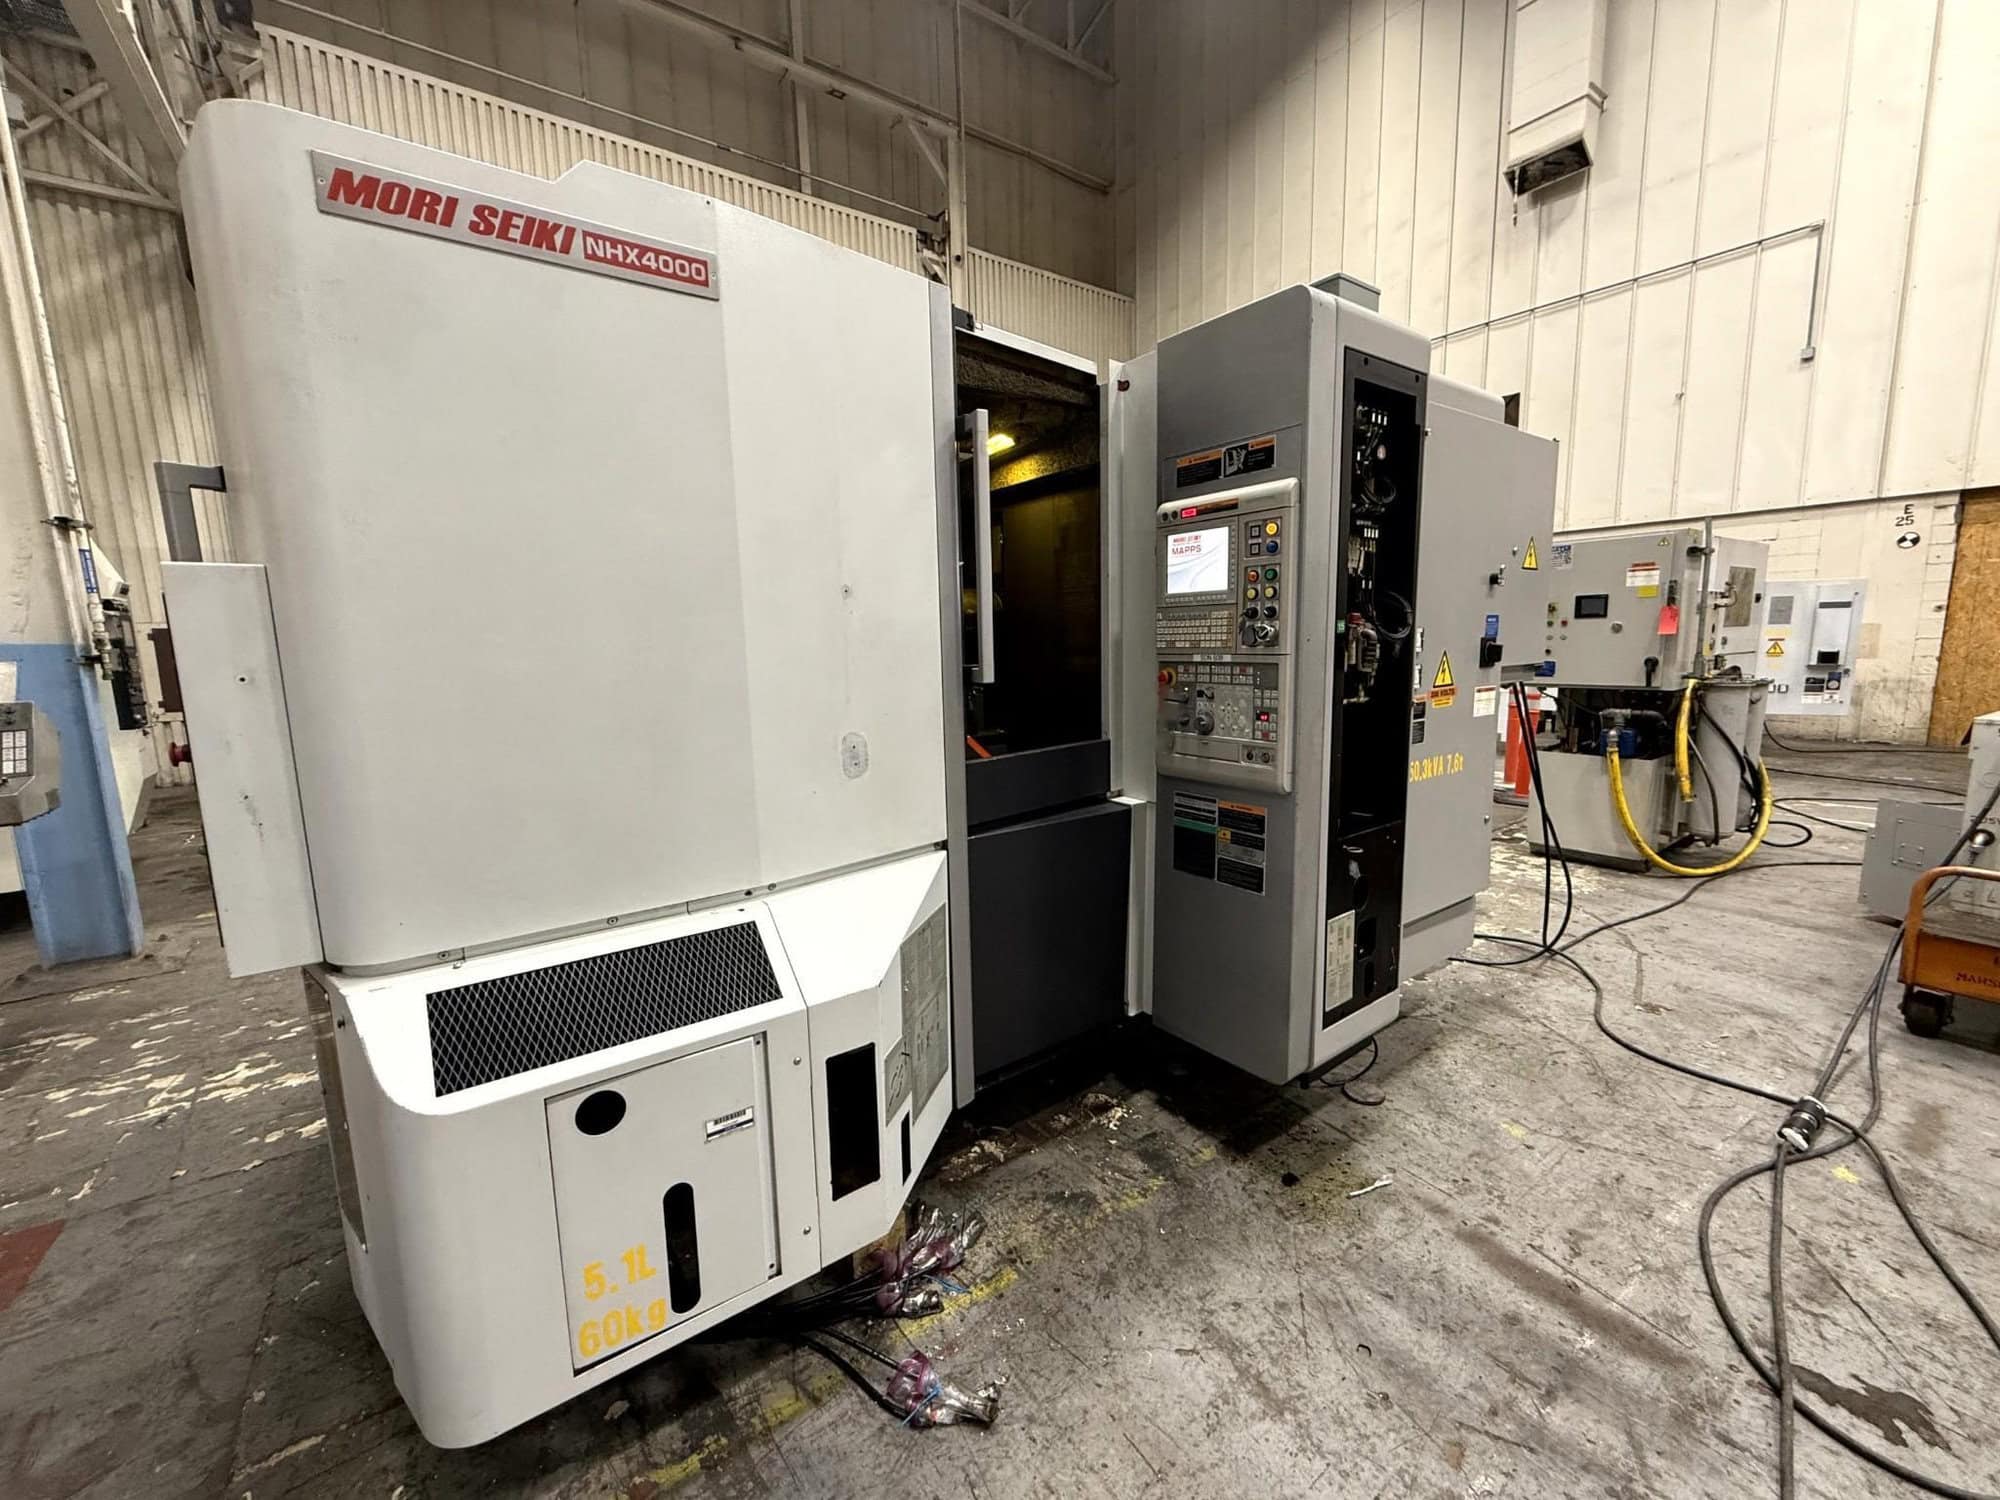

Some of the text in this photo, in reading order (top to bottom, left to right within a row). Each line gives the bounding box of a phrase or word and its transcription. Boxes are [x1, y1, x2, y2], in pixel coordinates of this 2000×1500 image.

[327, 168, 707, 282] MORI SEIKI NHX4000
[1895, 515, 1914, 527] 25
[1904, 503, 1914, 514] E
[1171, 544, 1202, 555] MAPPS
[583, 1243, 657, 1300] 5.1L
[578, 1298, 667, 1358] 60kg
